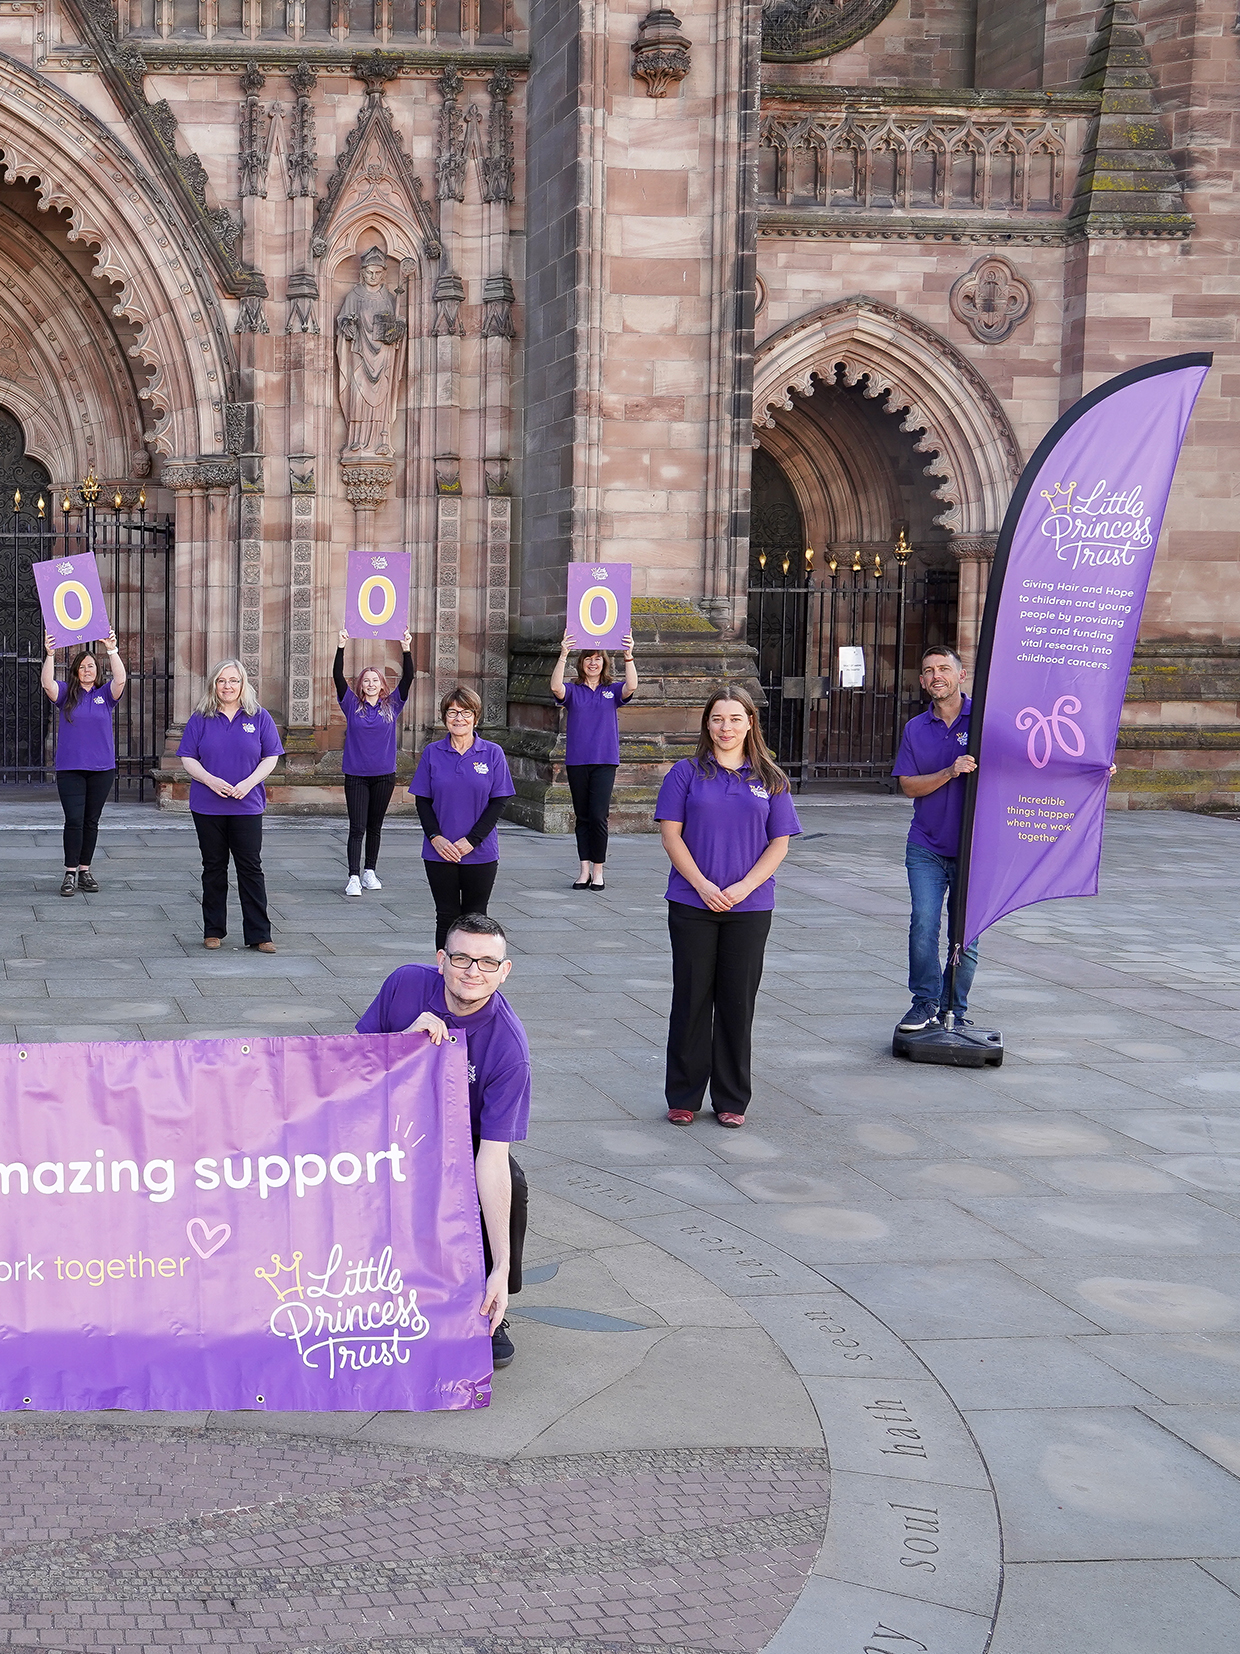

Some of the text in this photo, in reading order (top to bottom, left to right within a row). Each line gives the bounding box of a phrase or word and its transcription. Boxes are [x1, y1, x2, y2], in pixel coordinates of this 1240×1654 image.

[1073, 480, 1144, 518] Little
[1041, 514, 1153, 550] Princess
[1057, 541, 1135, 570] Trust
[53, 580, 93, 631] 0
[358, 575, 397, 626] 0
[1019, 594, 1131, 614] to children and young
[1022, 579, 1134, 598] Giving Hair and Hope
[579, 585, 618, 636] 0
[1020, 610, 1125, 628] people by providing
[1021, 638, 1112, 655] vital research into
[1025, 624, 1114, 642] wigs and funding
[1017, 653, 1110, 670] childhood cancers.
[1007, 806, 1075, 820] things happen
[1018, 794, 1066, 807] Incredible
[1006, 819, 1072, 832] when we work
[1018, 831, 1058, 843] together
[194, 1142, 407, 1199] support
[54, 1250, 191, 1287] together
[307, 1244, 404, 1299] Little
[270, 1289, 430, 1355] Princess
[804, 1309, 873, 1364] seen
[303, 1329, 412, 1379] Trust
[862, 1399, 928, 1460] hath
[887, 1501, 940, 1573] soul
